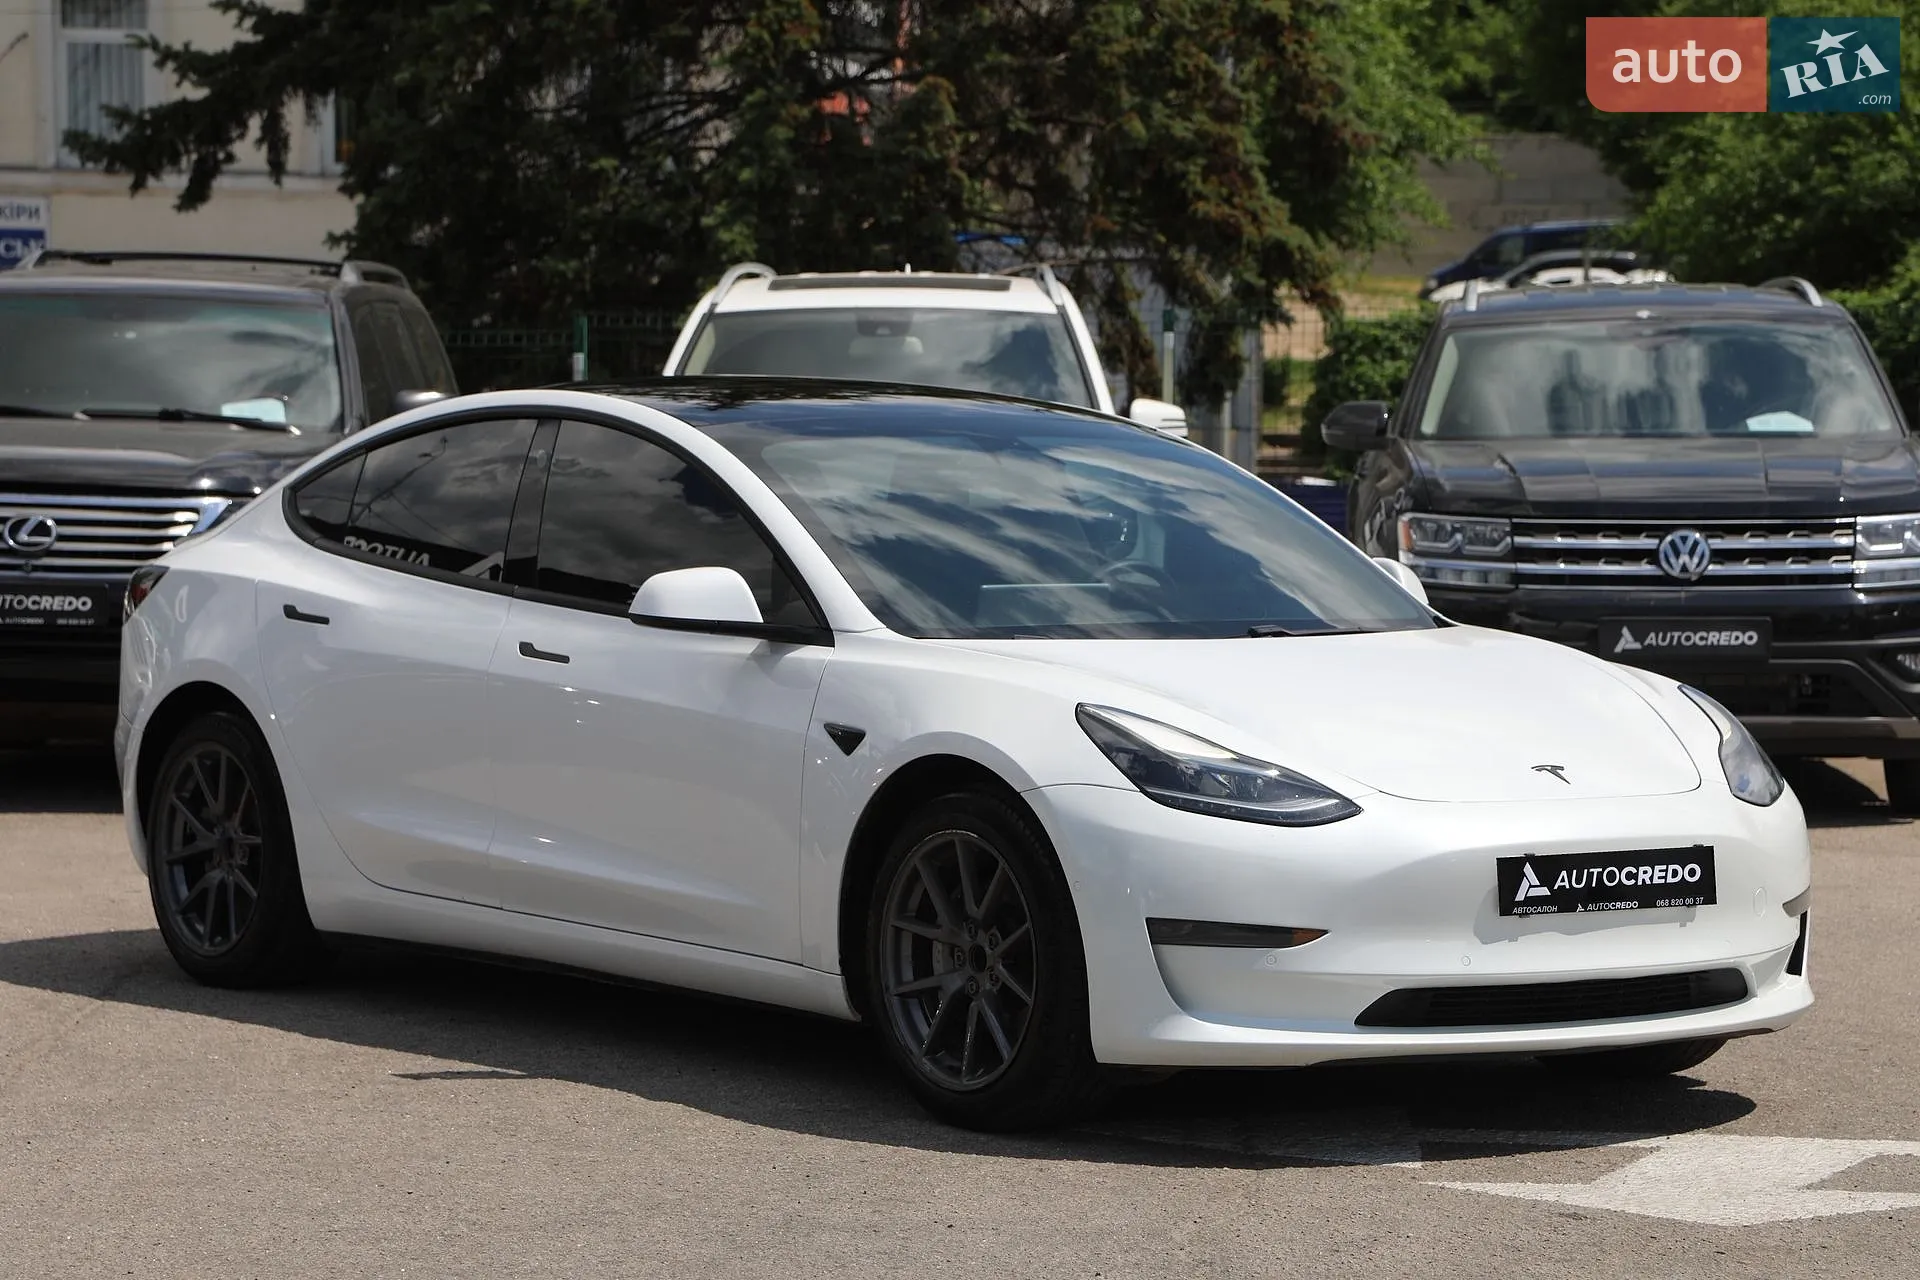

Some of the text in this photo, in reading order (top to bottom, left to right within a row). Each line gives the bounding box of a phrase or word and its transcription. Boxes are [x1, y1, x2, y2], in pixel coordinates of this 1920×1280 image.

[1643, 630, 1758, 647] AUTOCREDO
[1553, 863, 1702, 890] AUTOCREDO
[1587, 901, 1639, 911] AUTOCREDO
[1656, 899, 1669, 907] 068
[1670, 898, 1684, 906] 820
[1684, 897, 1694, 905] 00
[1512, 905, 1558, 914] АВТОСАЛОН
